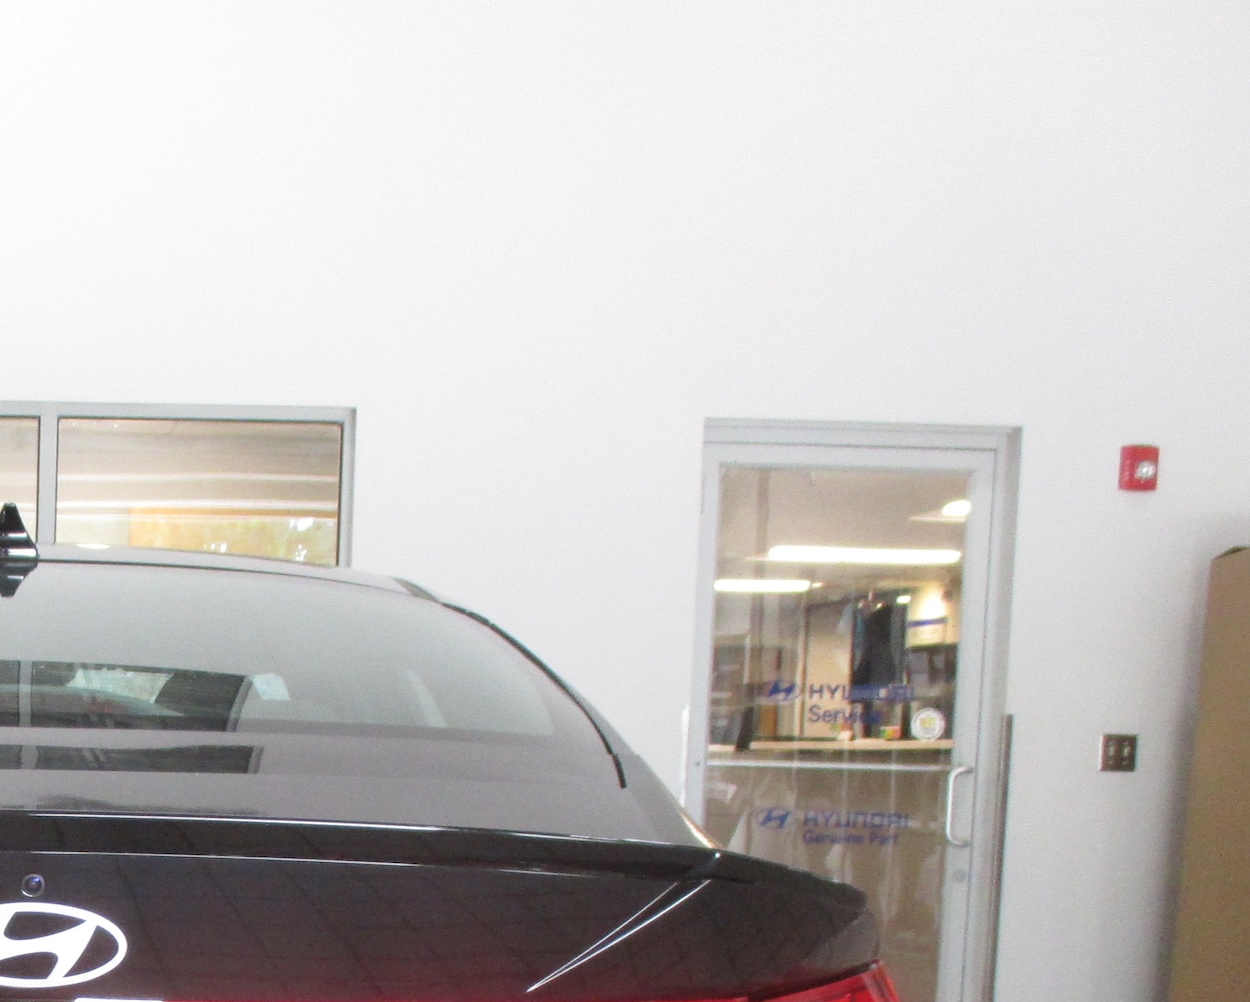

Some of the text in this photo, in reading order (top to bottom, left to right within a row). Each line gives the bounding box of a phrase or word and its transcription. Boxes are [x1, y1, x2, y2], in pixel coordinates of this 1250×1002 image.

[808, 683, 915, 701] HYUAI
[808, 704, 882, 724] Servi
[803, 810, 909, 828] HYUNDAI
